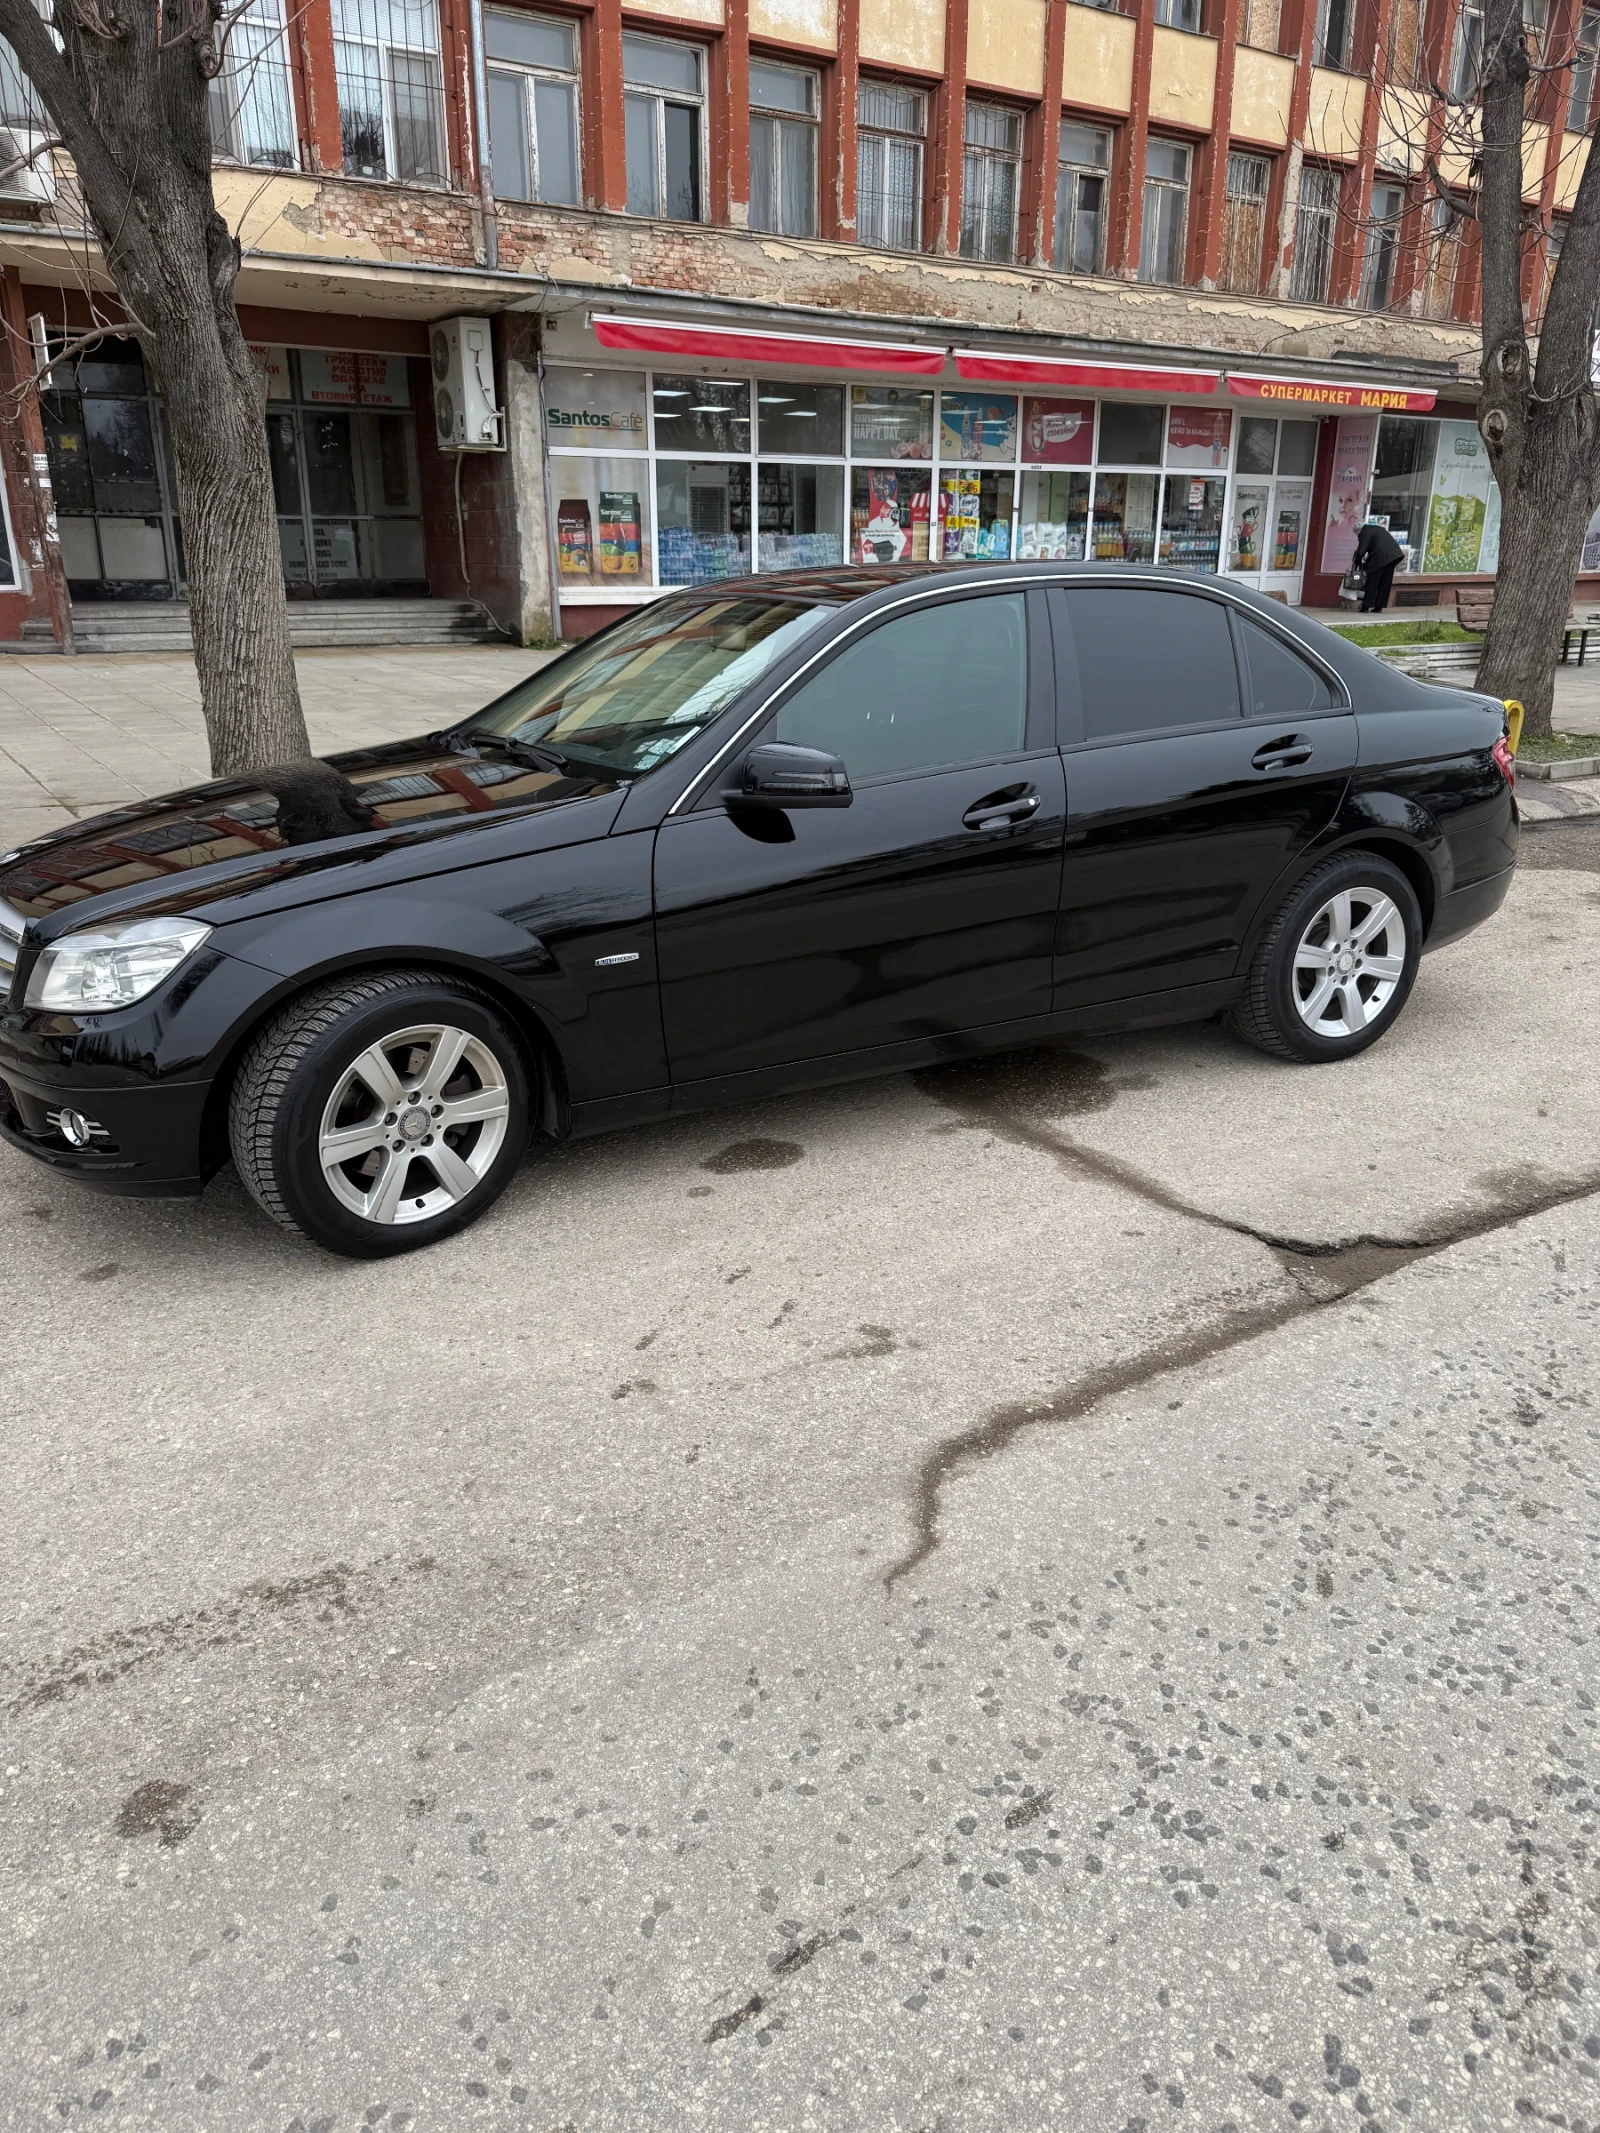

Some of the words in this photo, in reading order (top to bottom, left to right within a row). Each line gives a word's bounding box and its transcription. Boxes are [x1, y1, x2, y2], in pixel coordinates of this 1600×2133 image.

[324, 355, 388, 368] ТРИКОТАЖ
[332, 365, 387, 377] РАБОТНО
[348, 384, 367, 393] НА
[311, 390, 356, 401] ВТОРИЯ
[363, 394, 393, 404] ЕТАЖ
[1260, 384, 1352, 405] СУПЕРМАРКЕТ
[1360, 391, 1408, 409] МАРИЯ
[854, 423, 881, 440] HAPPY
